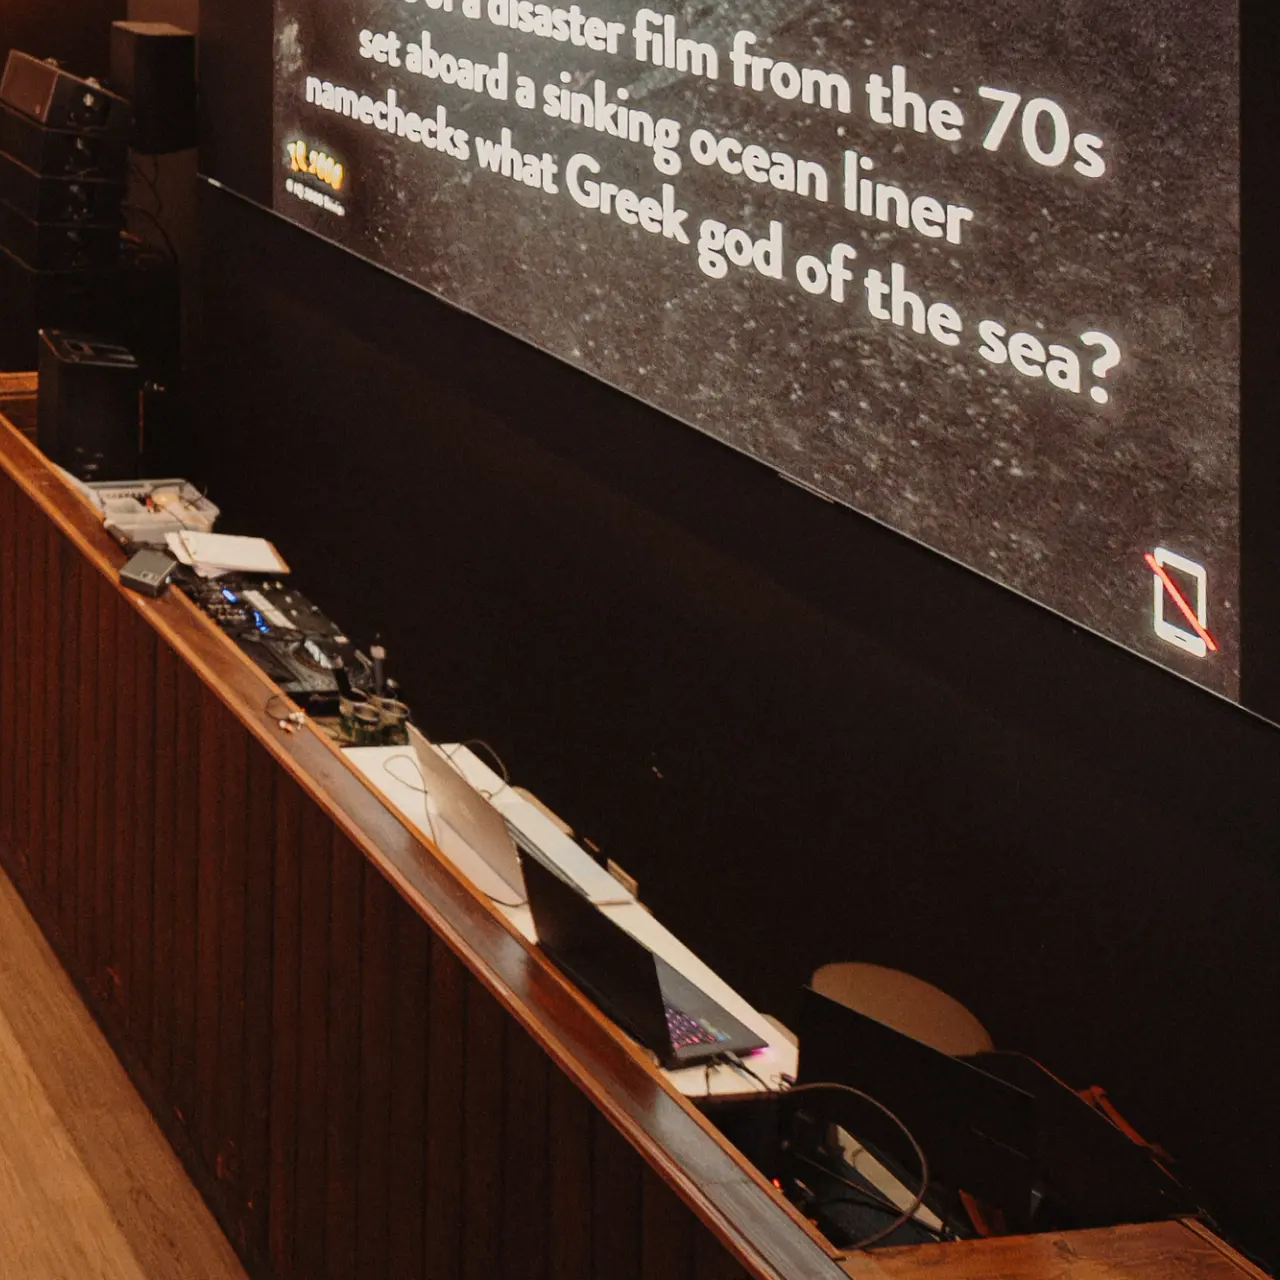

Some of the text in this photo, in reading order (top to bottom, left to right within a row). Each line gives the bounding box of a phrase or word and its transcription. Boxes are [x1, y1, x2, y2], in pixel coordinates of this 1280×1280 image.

[358, 28, 974, 245] set aboard a sinking ocean liner
[631, 8, 719, 80] film
[728, 29, 852, 114] from
[865, 64, 965, 142] the
[978, 85, 1106, 178] 70s
[305, 76, 1122, 405] namechecks what Greek god of the sea?
